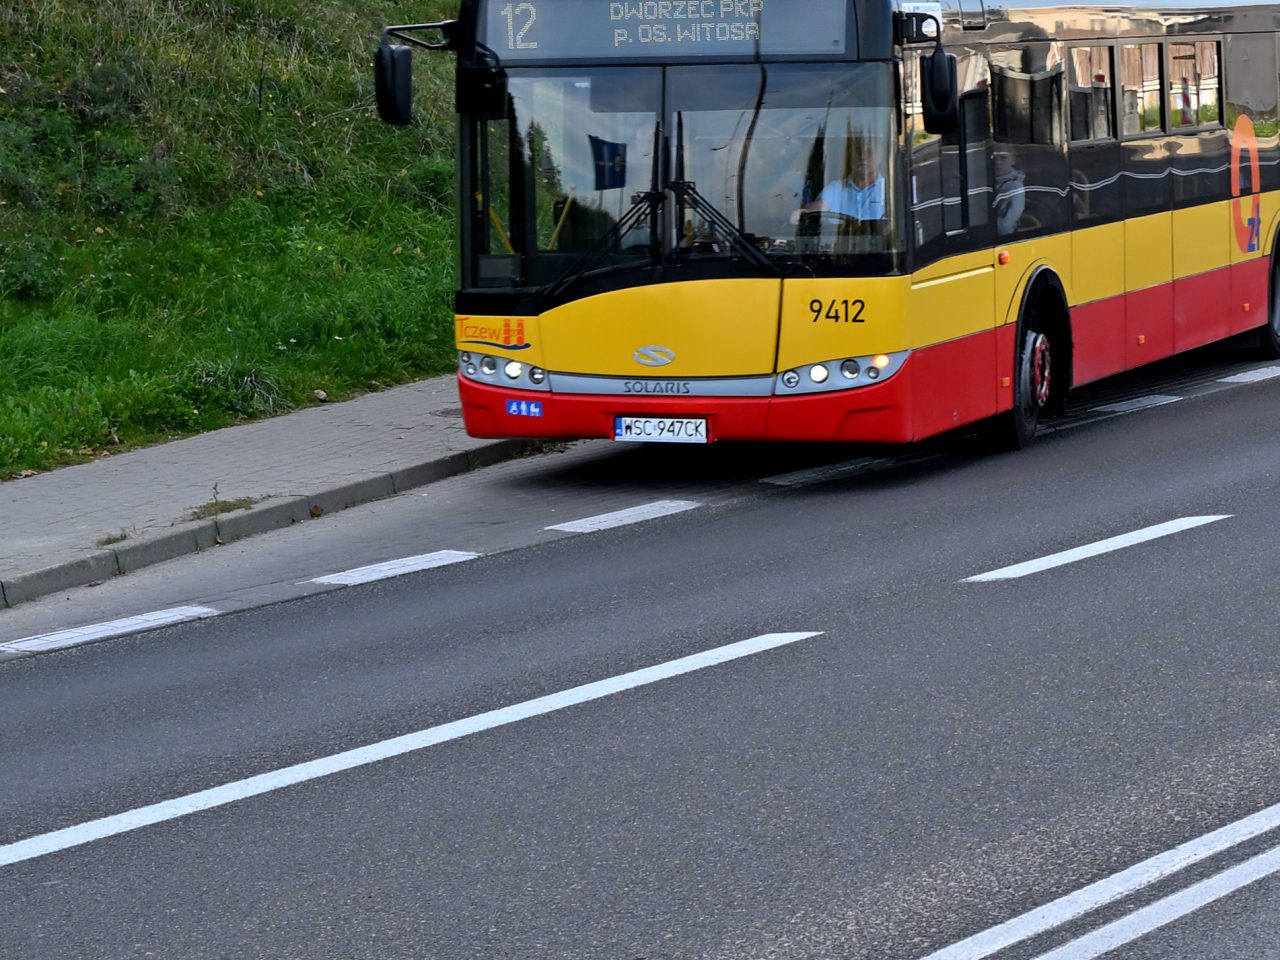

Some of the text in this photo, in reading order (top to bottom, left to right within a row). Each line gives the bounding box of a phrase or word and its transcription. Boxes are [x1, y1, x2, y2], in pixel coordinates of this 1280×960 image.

[610, 0, 764, 21] DWORZEC PKP
[500, 3, 537, 49] 12
[638, 24, 671, 43] OS.
[676, 22, 760, 41] WITOSA
[809, 299, 865, 323] 9412
[456, 317, 501, 342] Tczew
[623, 381, 691, 394] SOLARIS
[623, 419, 704, 438] WSC 947CK
